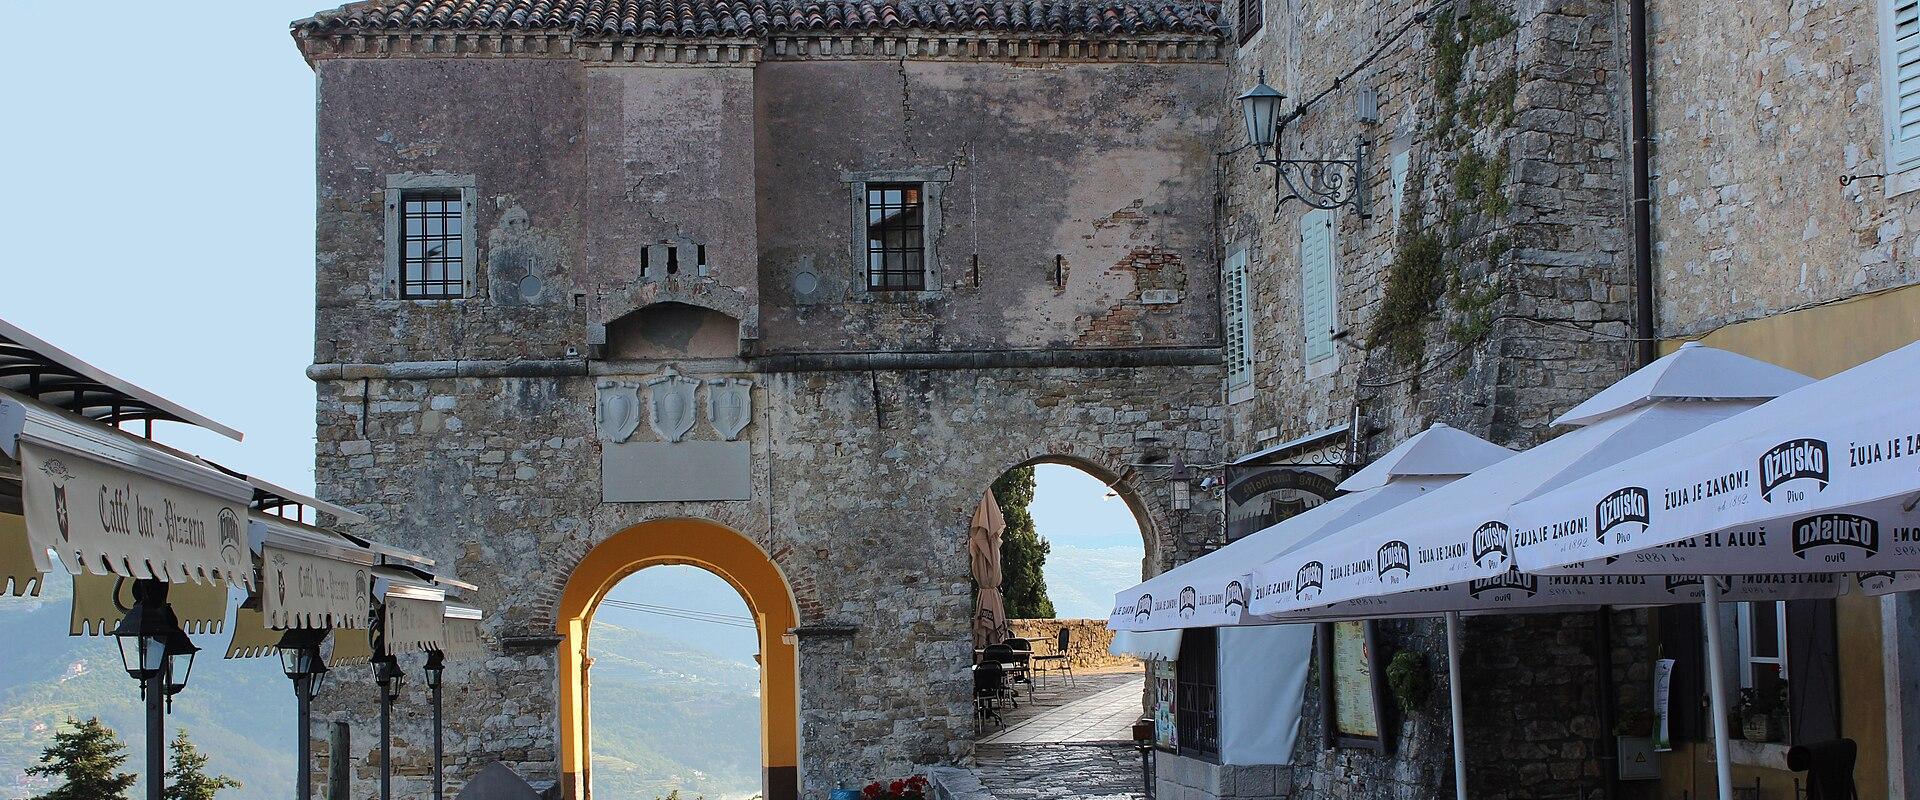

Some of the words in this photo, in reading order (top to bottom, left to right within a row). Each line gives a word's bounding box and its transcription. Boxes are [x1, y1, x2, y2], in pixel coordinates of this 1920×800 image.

[1763, 440, 1824, 488] Ožujsko
[1850, 442, 1882, 467] ŽUJA
[1887, 439, 1901, 460] JE
[1665, 488, 1689, 511] ŽUJA
[1692, 483, 1702, 502] JE
[1706, 469, 1749, 498] ZAKON!
[1787, 490, 1804, 503] Pivo
[135, 493, 155, 538] bar
[164, 498, 206, 551] Pizzeria
[1600, 488, 1646, 531] Ožujsko
[1514, 529, 1539, 549] ŽUJA
[1552, 516, 1588, 540] ZAKON!
[1379, 541, 1408, 572] Ožujsko
[1418, 546, 1435, 563] ŽUJA
